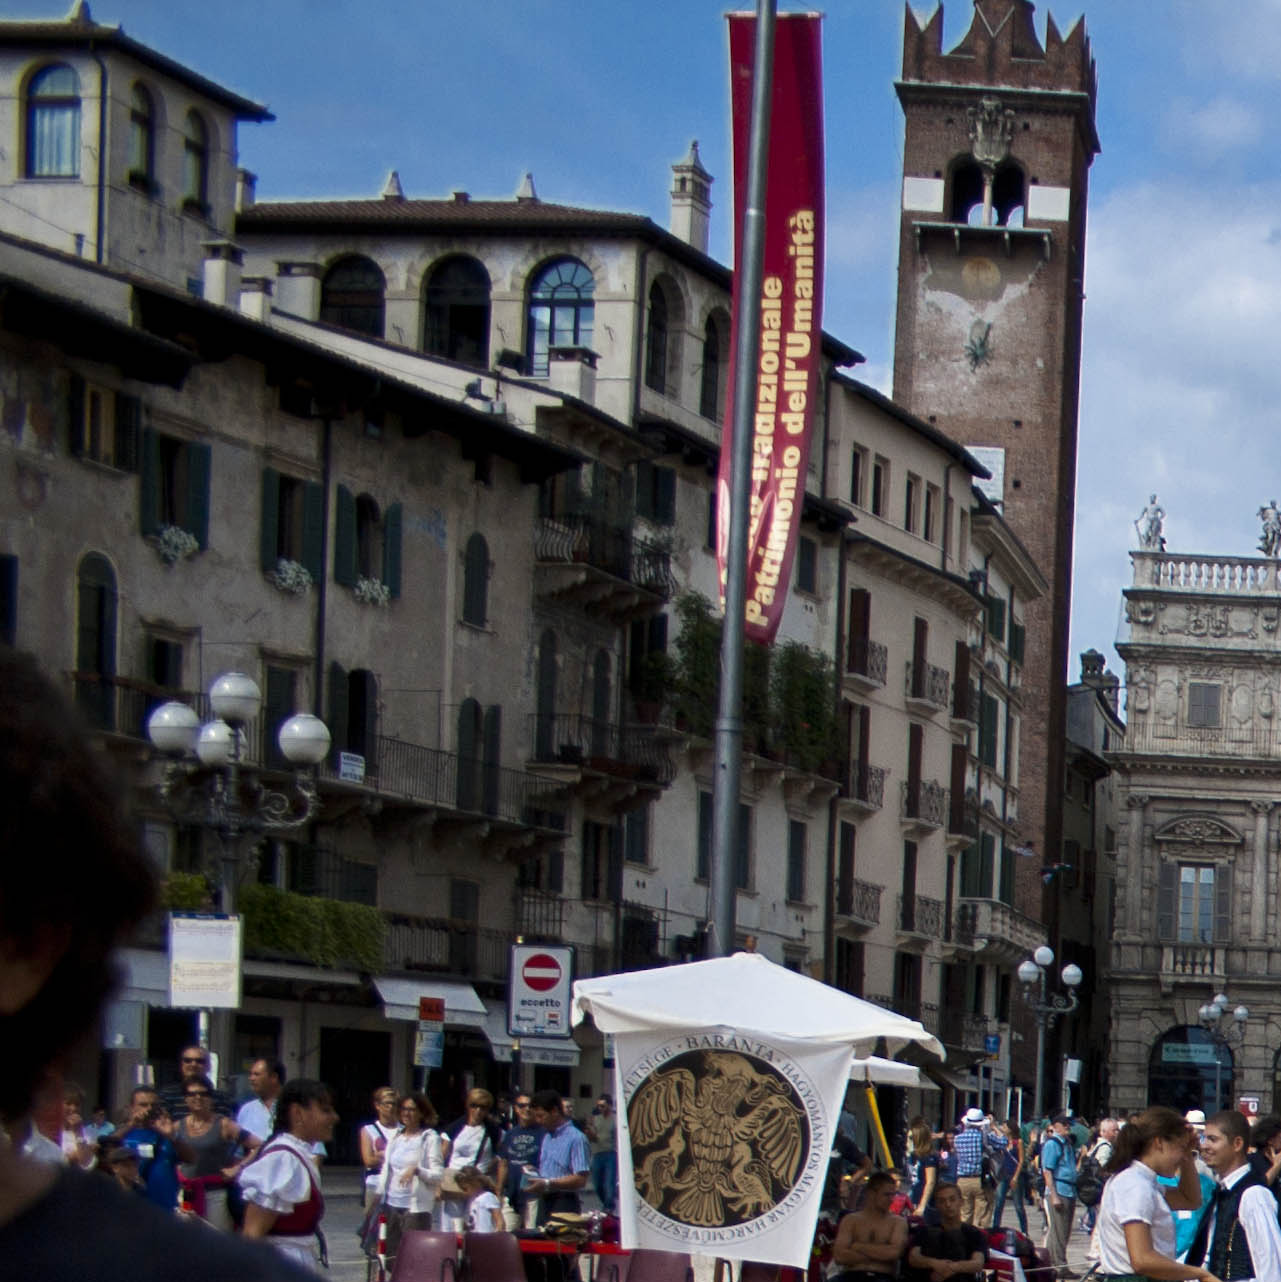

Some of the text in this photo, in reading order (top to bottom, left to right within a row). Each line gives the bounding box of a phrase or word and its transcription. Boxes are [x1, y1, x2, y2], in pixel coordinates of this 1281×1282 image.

[745, 446, 801, 627] Patrimonio
[781, 210, 815, 434] dell'Umanità
[520, 999, 561, 1008] eccetto
[686, 1034, 774, 1062] BARANTA
[768, 1173, 814, 1222] MAGYAR
